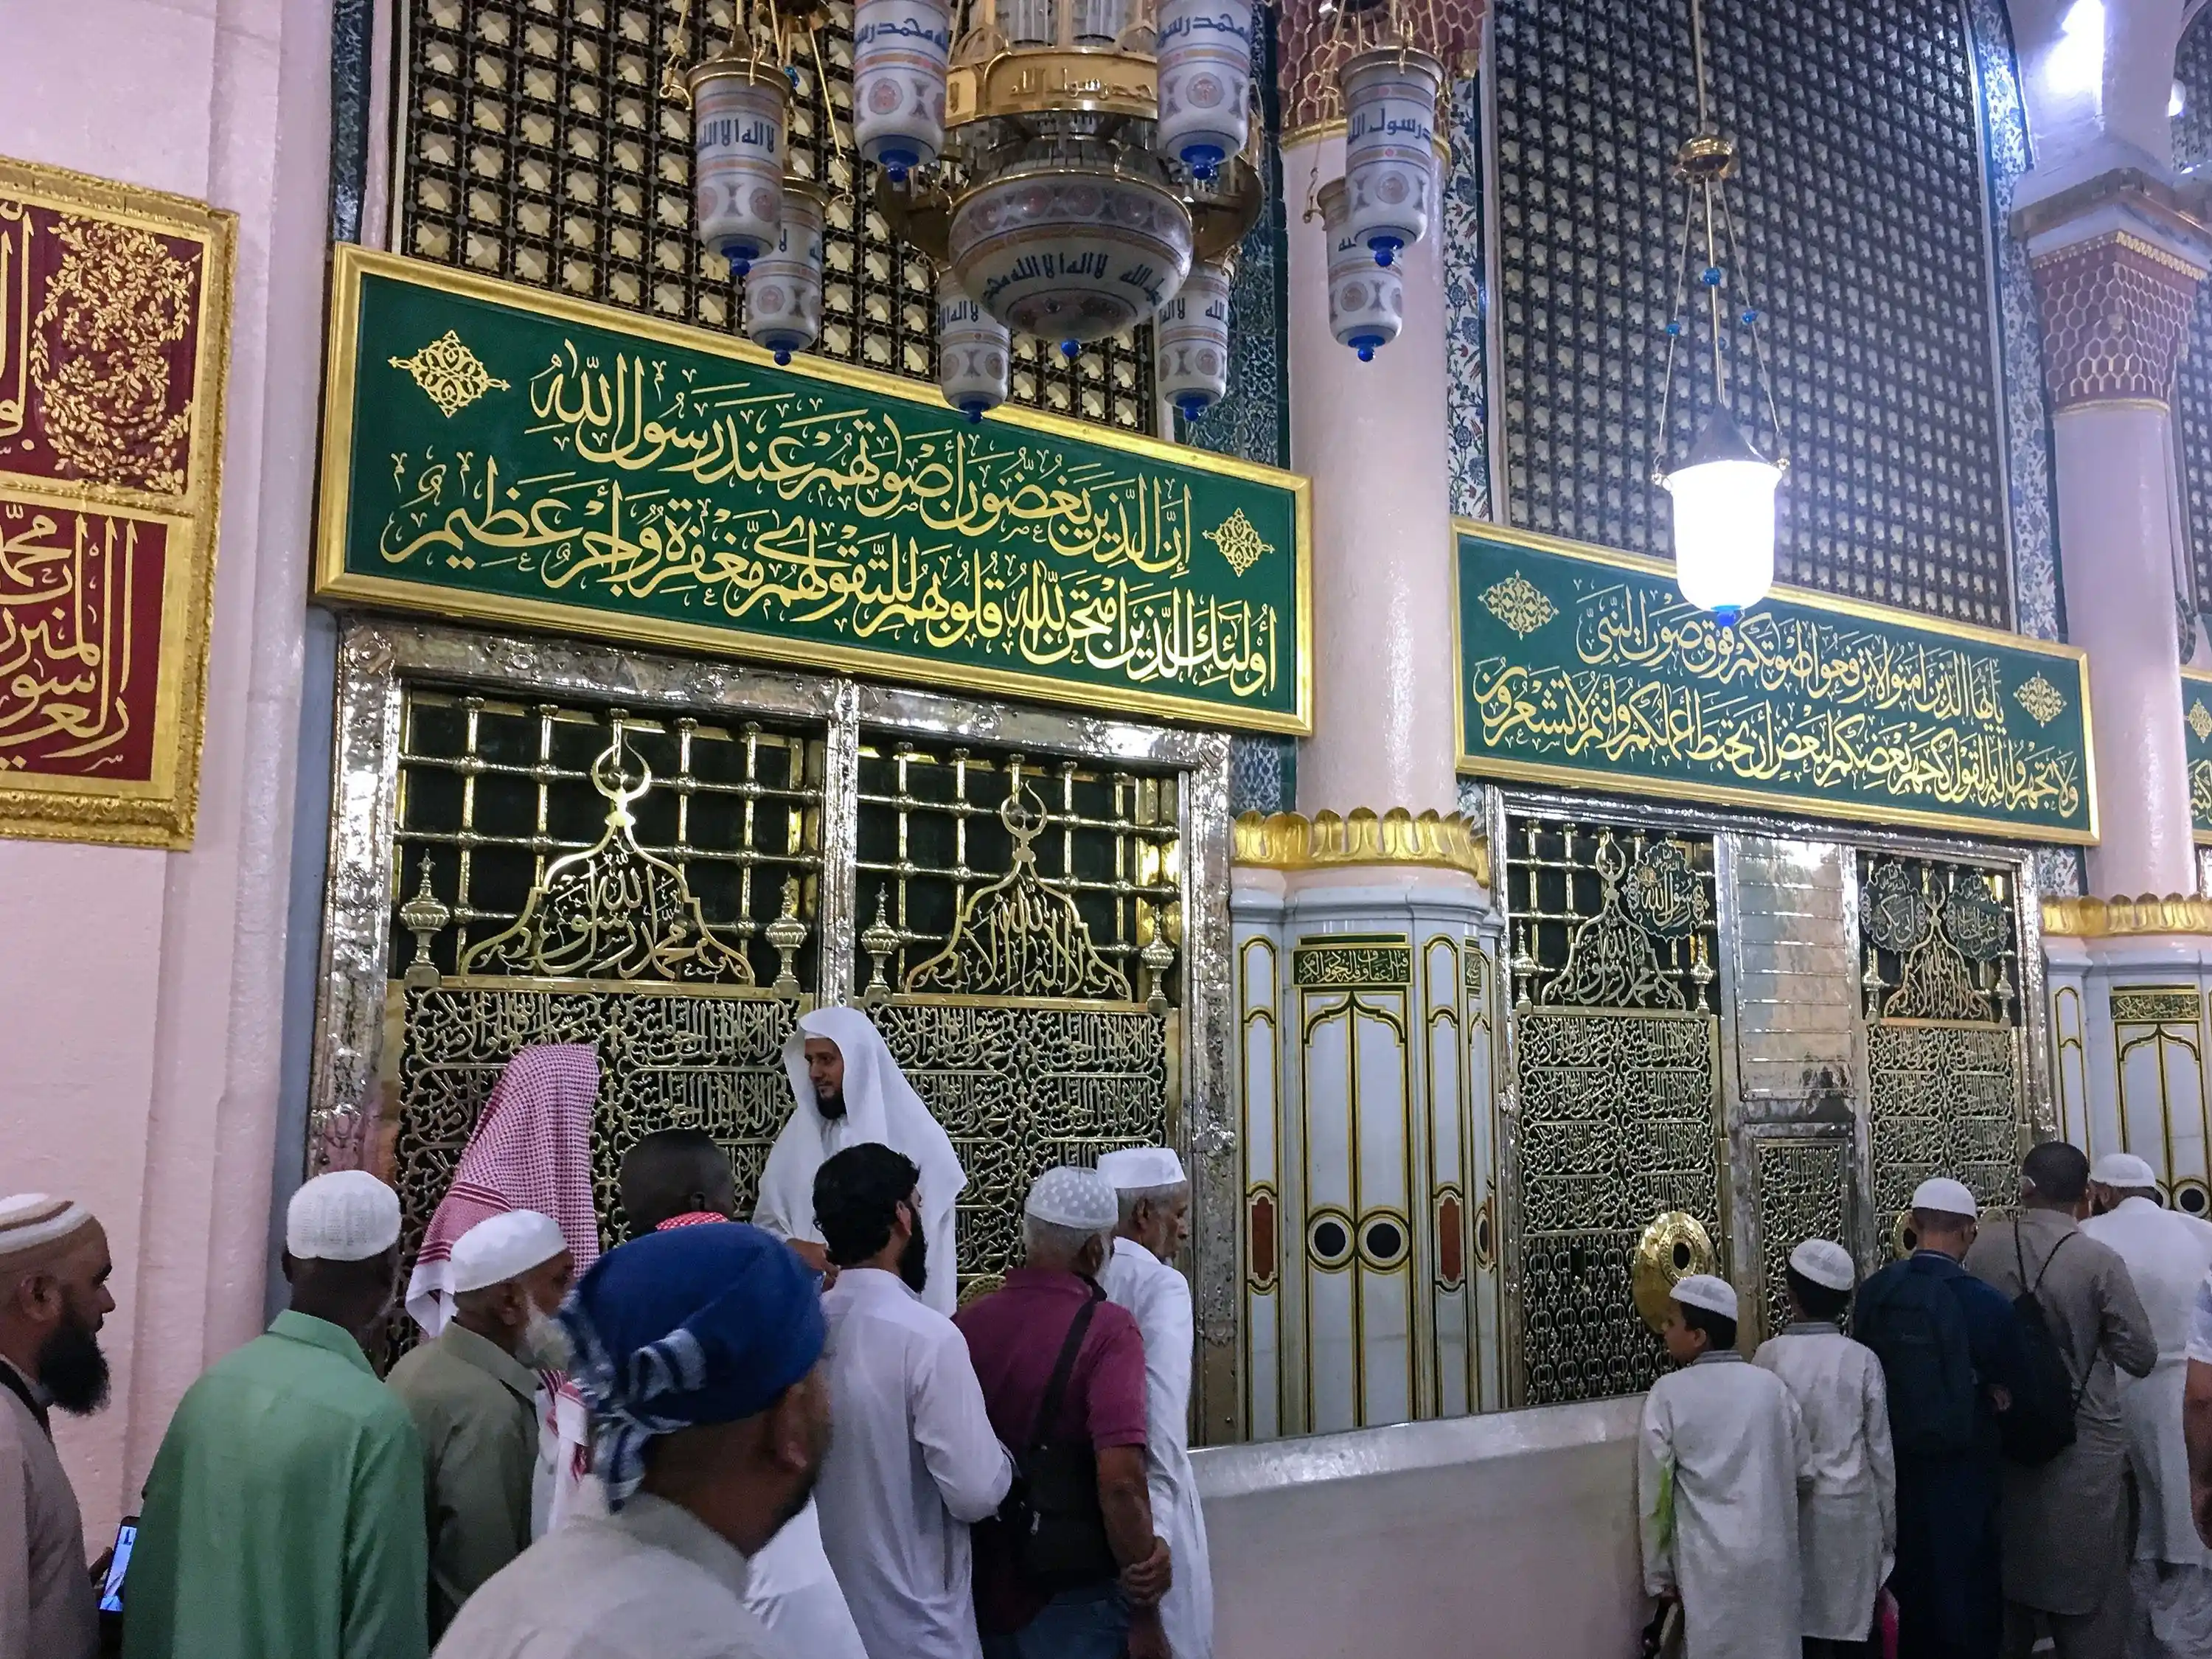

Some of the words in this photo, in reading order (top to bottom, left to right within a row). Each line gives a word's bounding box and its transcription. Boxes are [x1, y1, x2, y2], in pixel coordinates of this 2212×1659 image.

[1368, 108, 1422, 139] رسول
[529, 339, 627, 446] الله
[575, 355, 725, 473] رسول
[693, 414, 817, 485] عند
[380, 455, 584, 570] عظيم
[1048, 473, 1162, 564] الذين
[853, 548, 1004, 649] قلوبهم
[1085, 586, 1195, 682] الذين
